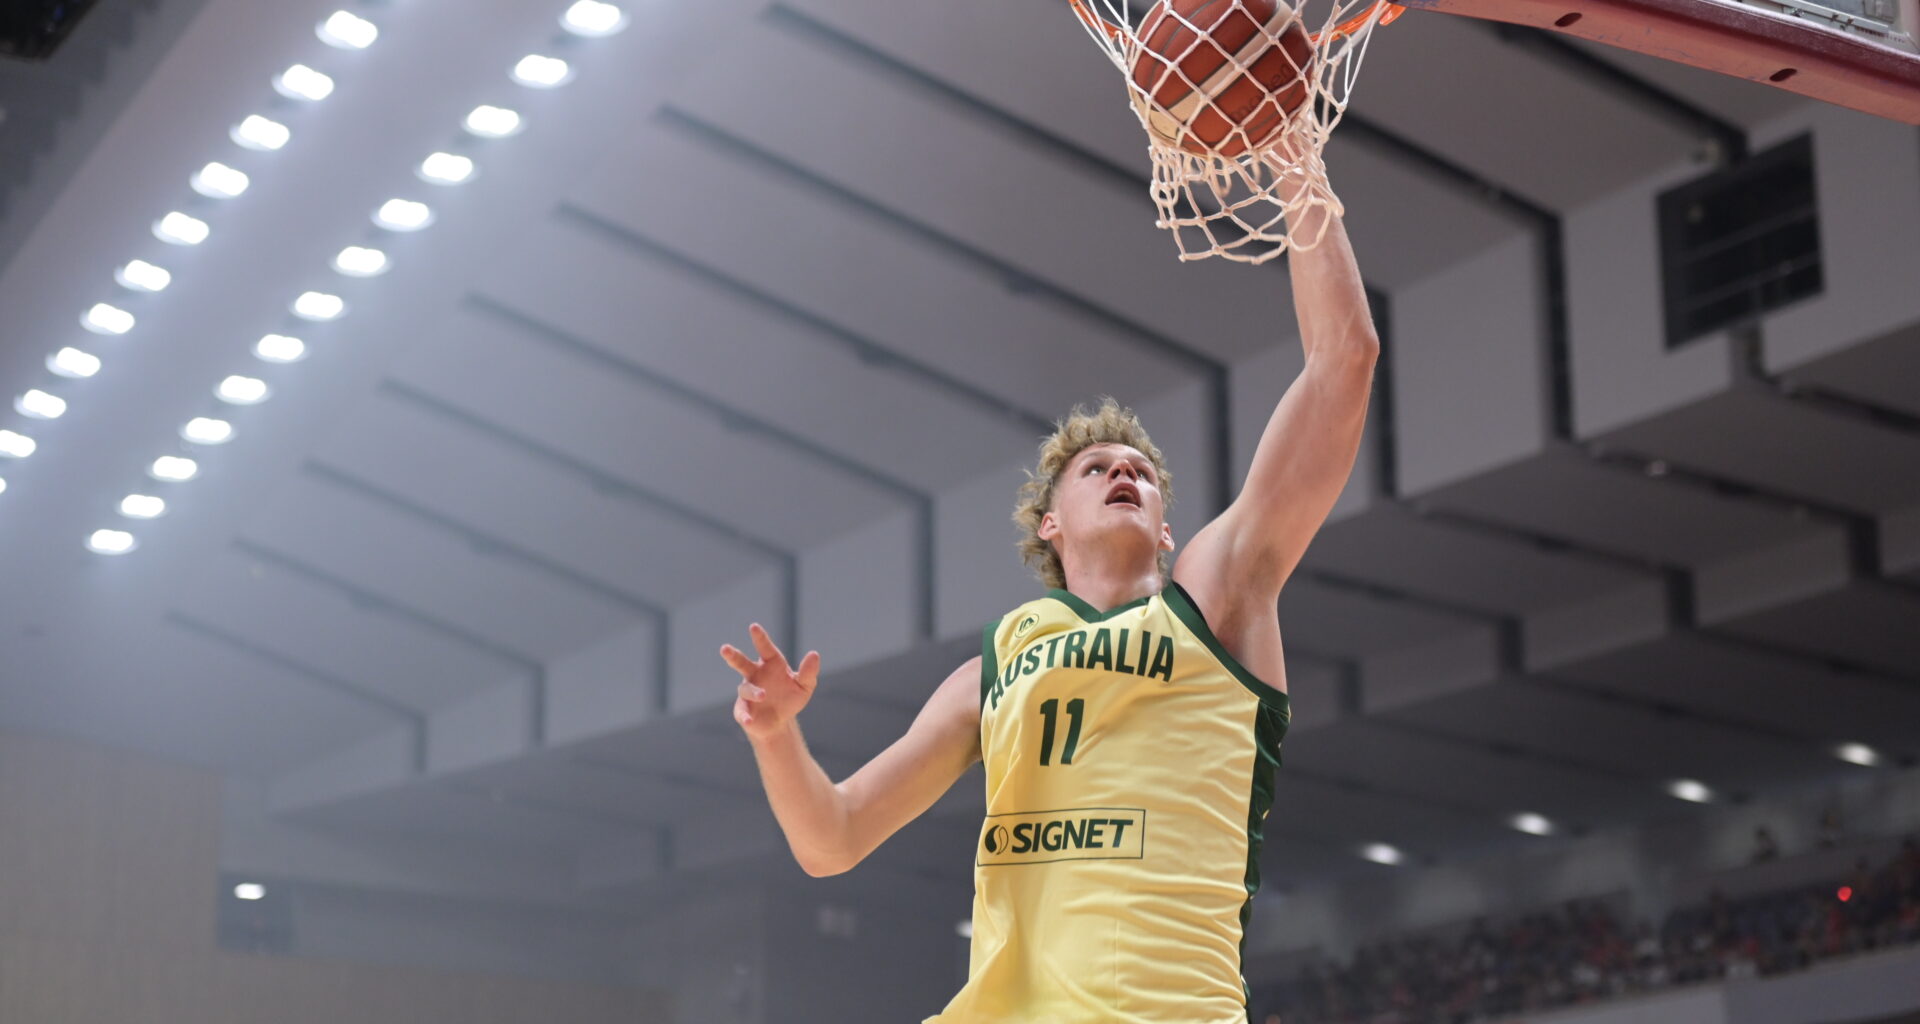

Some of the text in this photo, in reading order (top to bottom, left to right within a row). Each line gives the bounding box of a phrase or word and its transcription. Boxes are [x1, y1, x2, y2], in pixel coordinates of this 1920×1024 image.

[990, 628, 1174, 711] AUSTRALIA
[1039, 698, 1085, 766] 11
[1011, 819, 1133, 853] SIGNET
